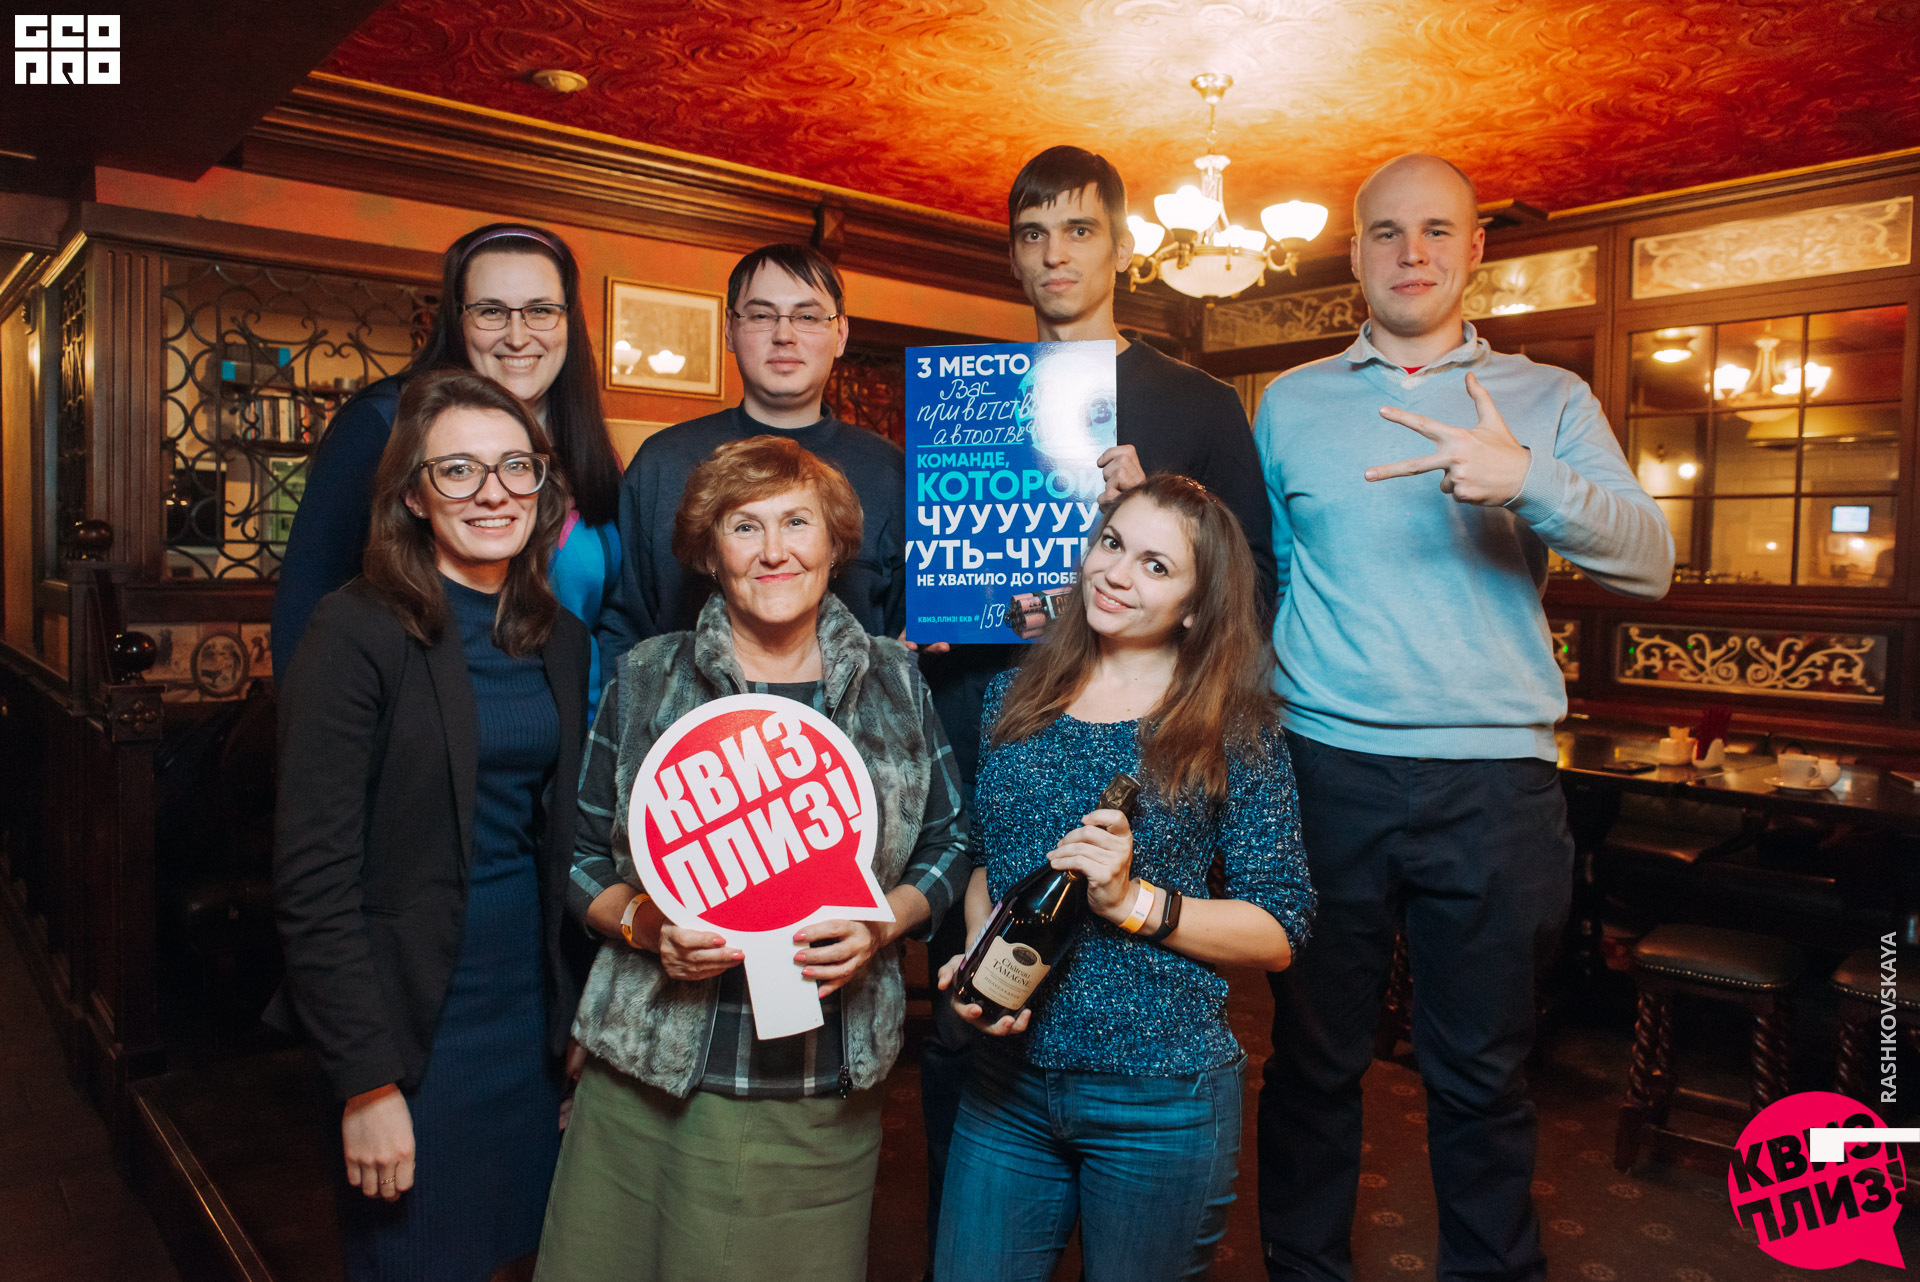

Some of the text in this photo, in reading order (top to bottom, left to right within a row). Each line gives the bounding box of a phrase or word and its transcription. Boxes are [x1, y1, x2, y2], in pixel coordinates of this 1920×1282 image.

[917, 353, 1030, 378] 3 МЕСТО
[940, 378, 996, 400] Вас
[917, 451, 1010, 468] КОМАНДЕ,
[917, 571, 1078, 587] НЕ ХВАТИЛО ДО ПОБЕ
[647, 711, 833, 845] КВИЗ,
[661, 765, 863, 916] ПЛИЗ!
